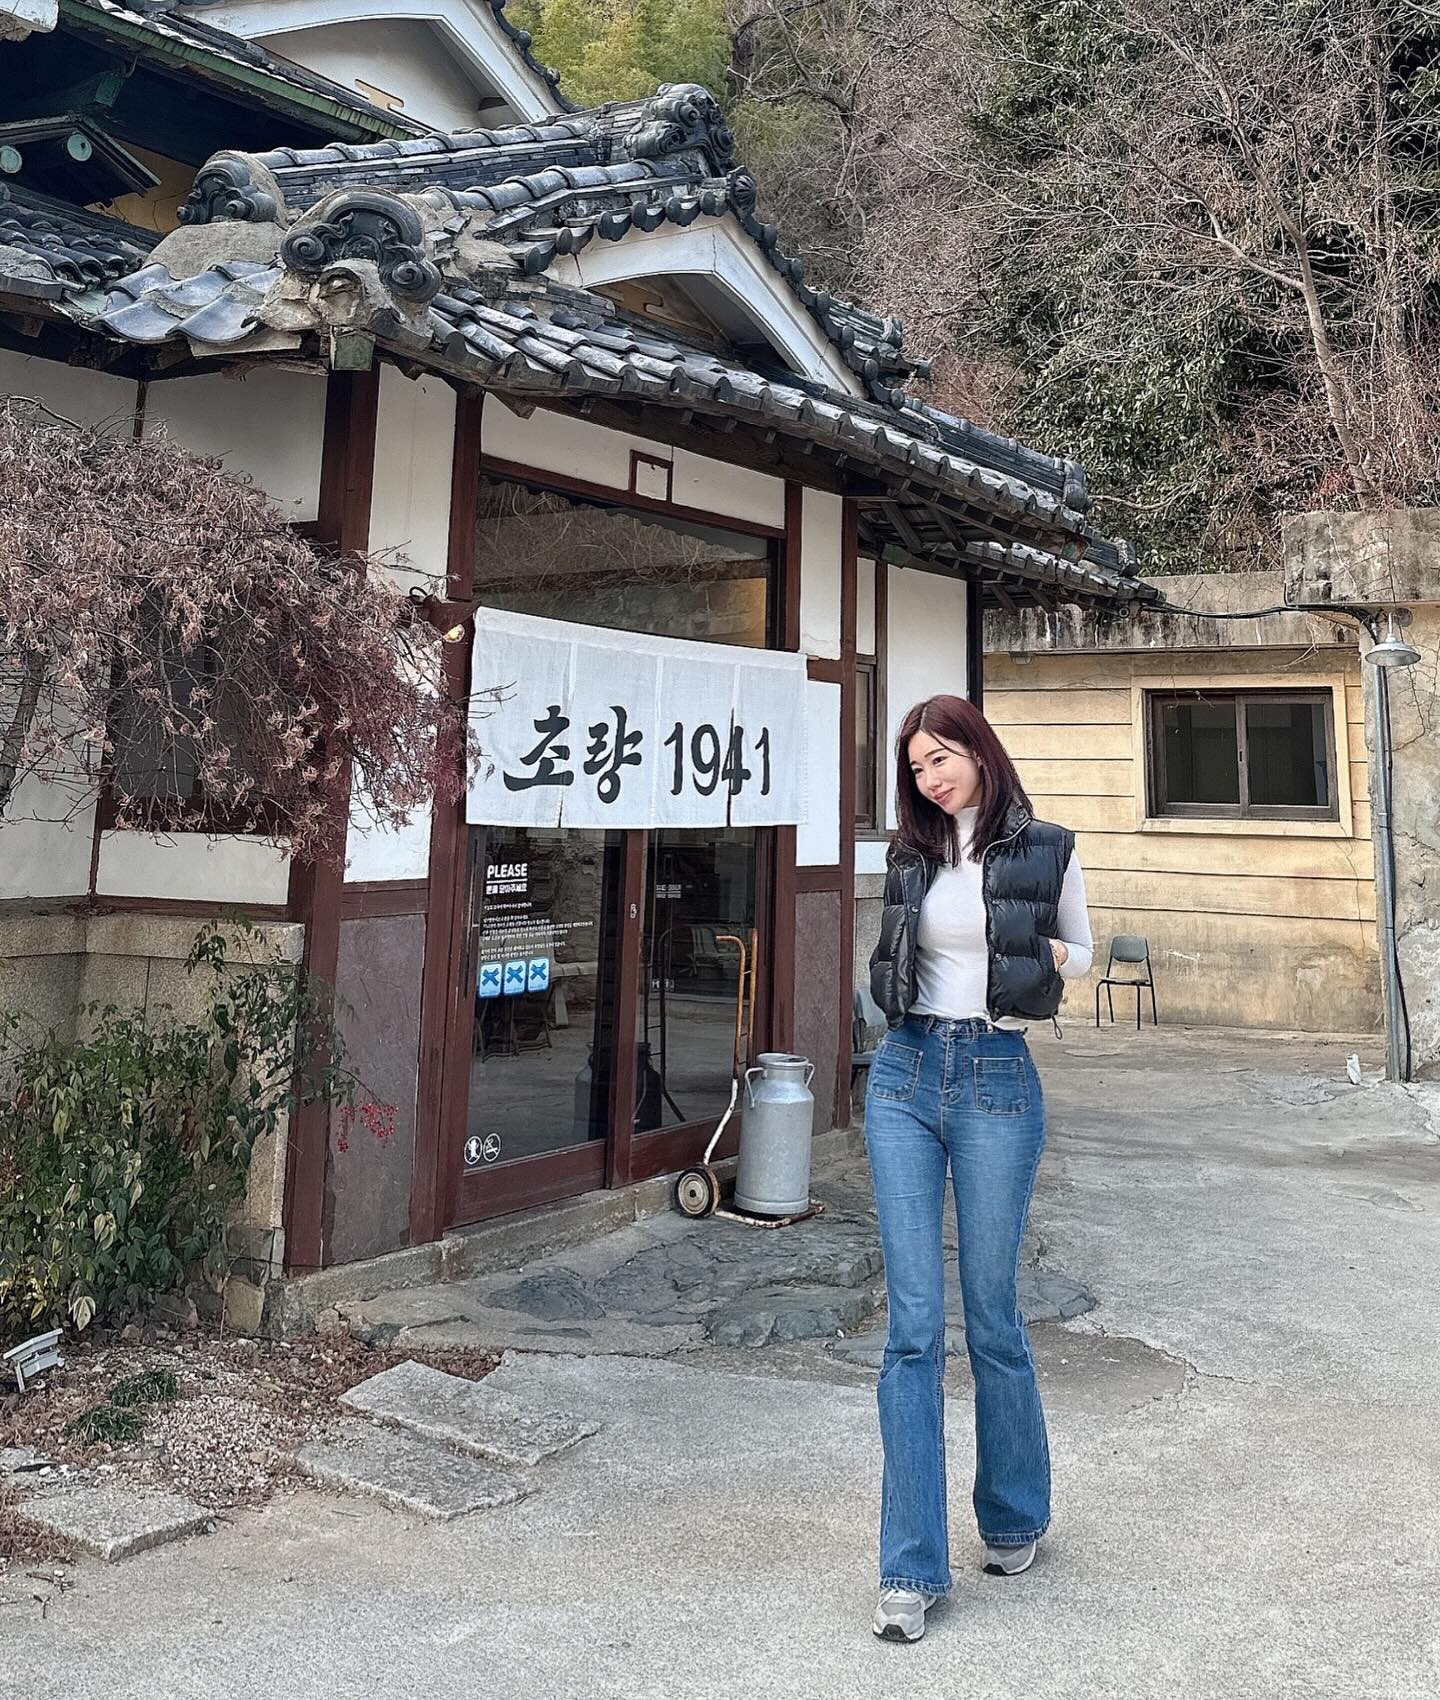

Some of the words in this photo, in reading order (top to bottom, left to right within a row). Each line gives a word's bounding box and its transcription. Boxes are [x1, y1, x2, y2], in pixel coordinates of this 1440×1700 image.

[503, 705, 643, 804] 초량
[664, 721, 770, 796] 1941
[487, 863, 528, 879] PLEASE
